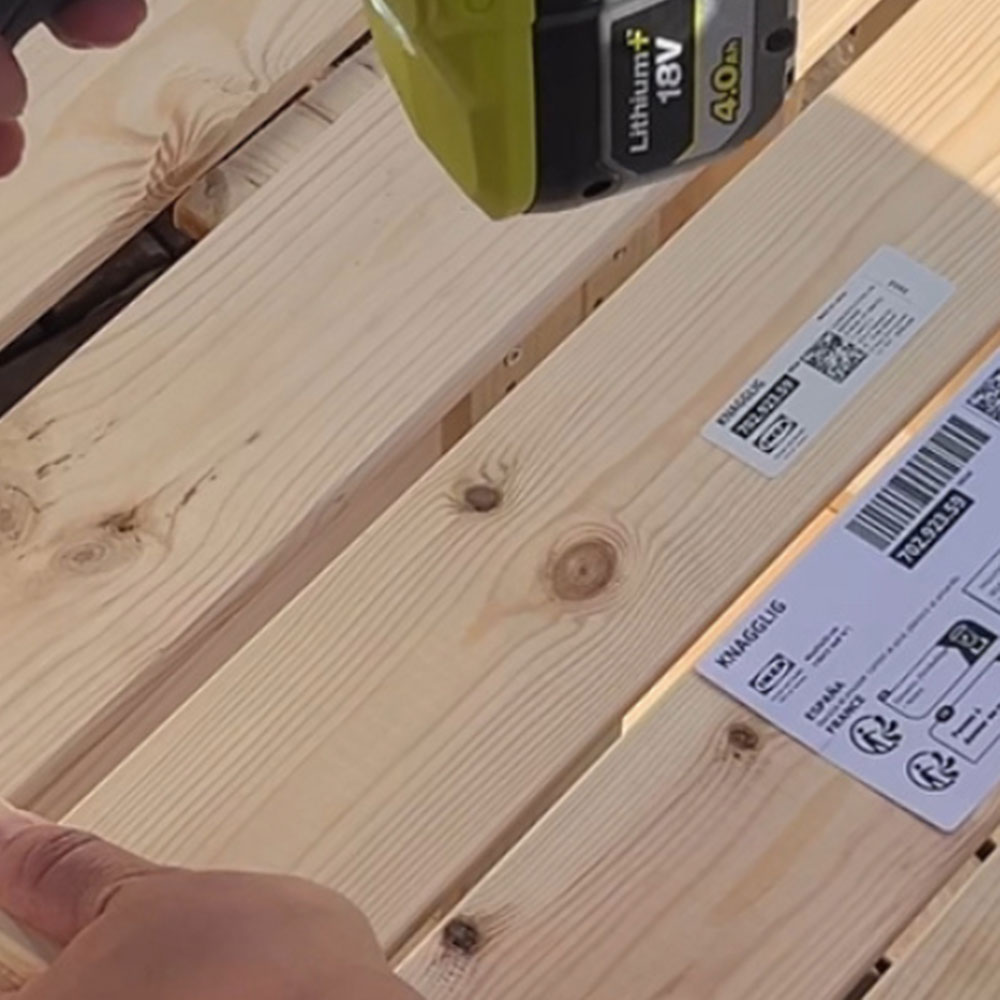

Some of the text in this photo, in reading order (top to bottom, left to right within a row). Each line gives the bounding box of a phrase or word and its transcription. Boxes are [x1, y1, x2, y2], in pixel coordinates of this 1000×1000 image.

[654, 35, 683, 104] 18V
[715, 377, 766, 426] KNAGGLIG
[756, 417, 793, 451] IKEA
[896, 494, 968, 565] 702.923.59
[714, 599, 787, 670] KNAGGLIG
[754, 656, 791, 692] IKEA
[804, 680, 846, 722] ESPAÑA
[825, 693, 867, 735] FRANCE
